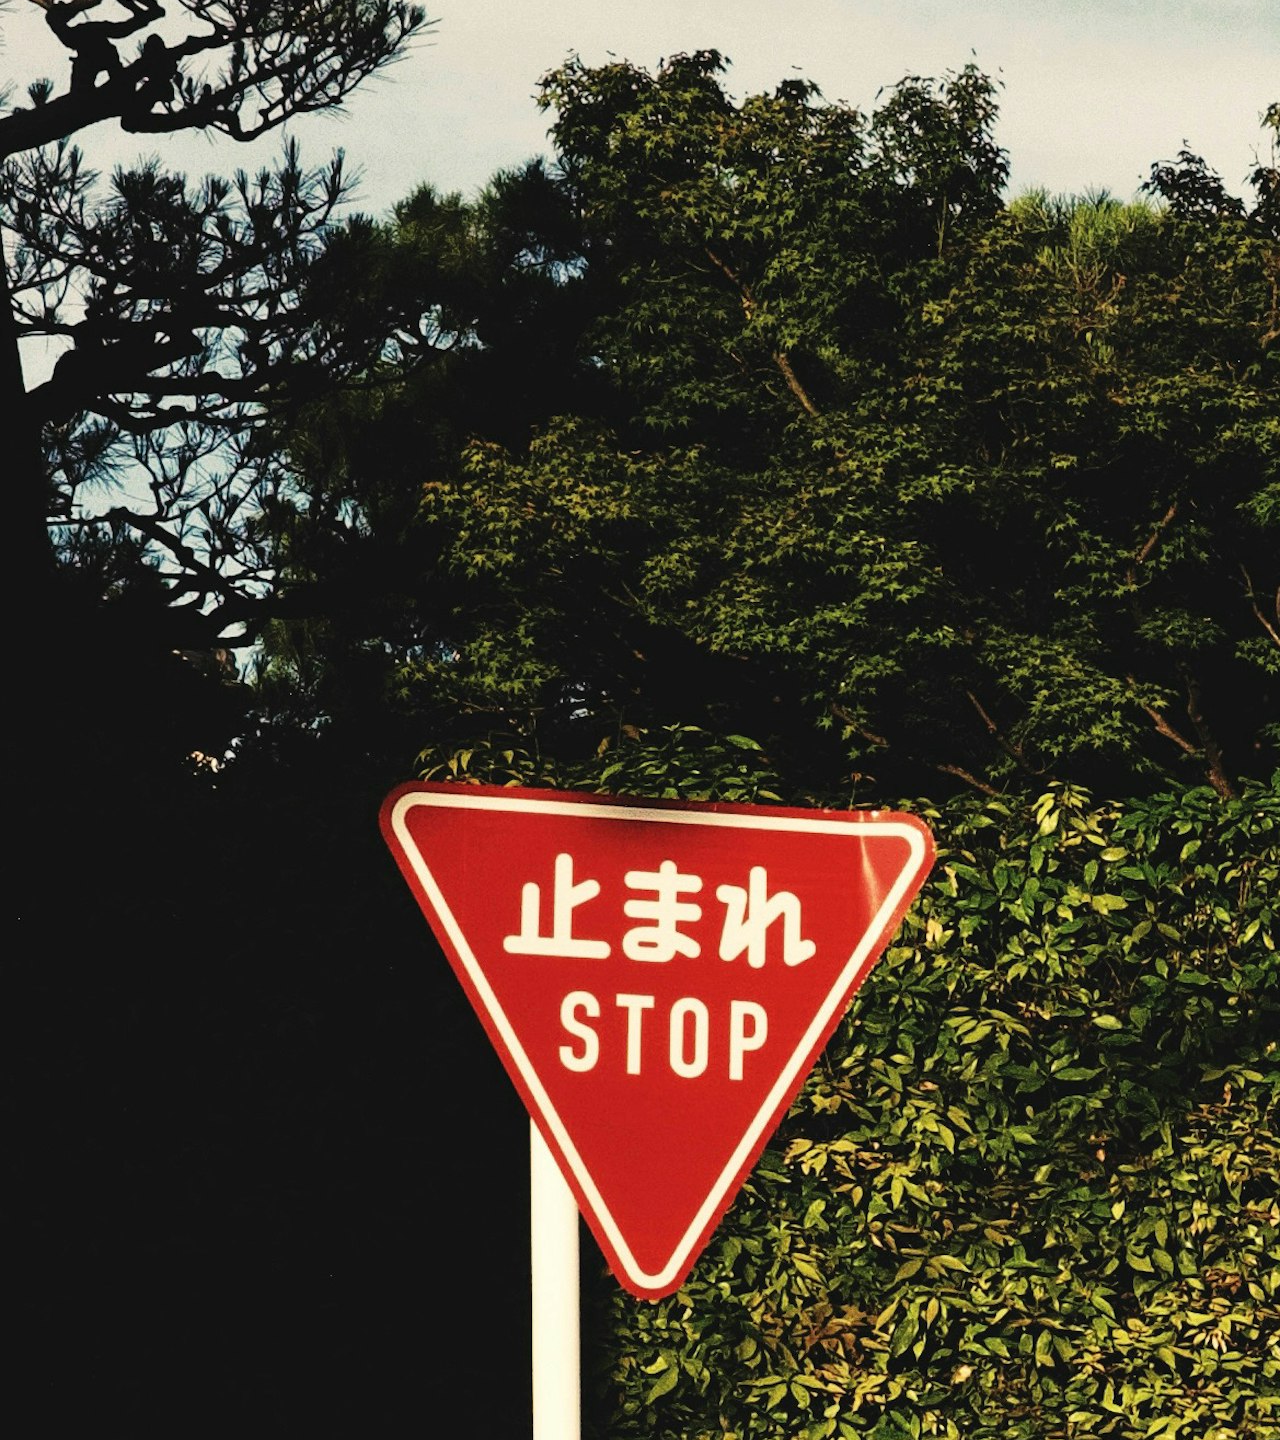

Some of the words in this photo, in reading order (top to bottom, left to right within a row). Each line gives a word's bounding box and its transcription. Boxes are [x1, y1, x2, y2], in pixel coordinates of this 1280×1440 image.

[503, 853, 817, 969] 止まれ
[559, 990, 768, 1081] STOP
